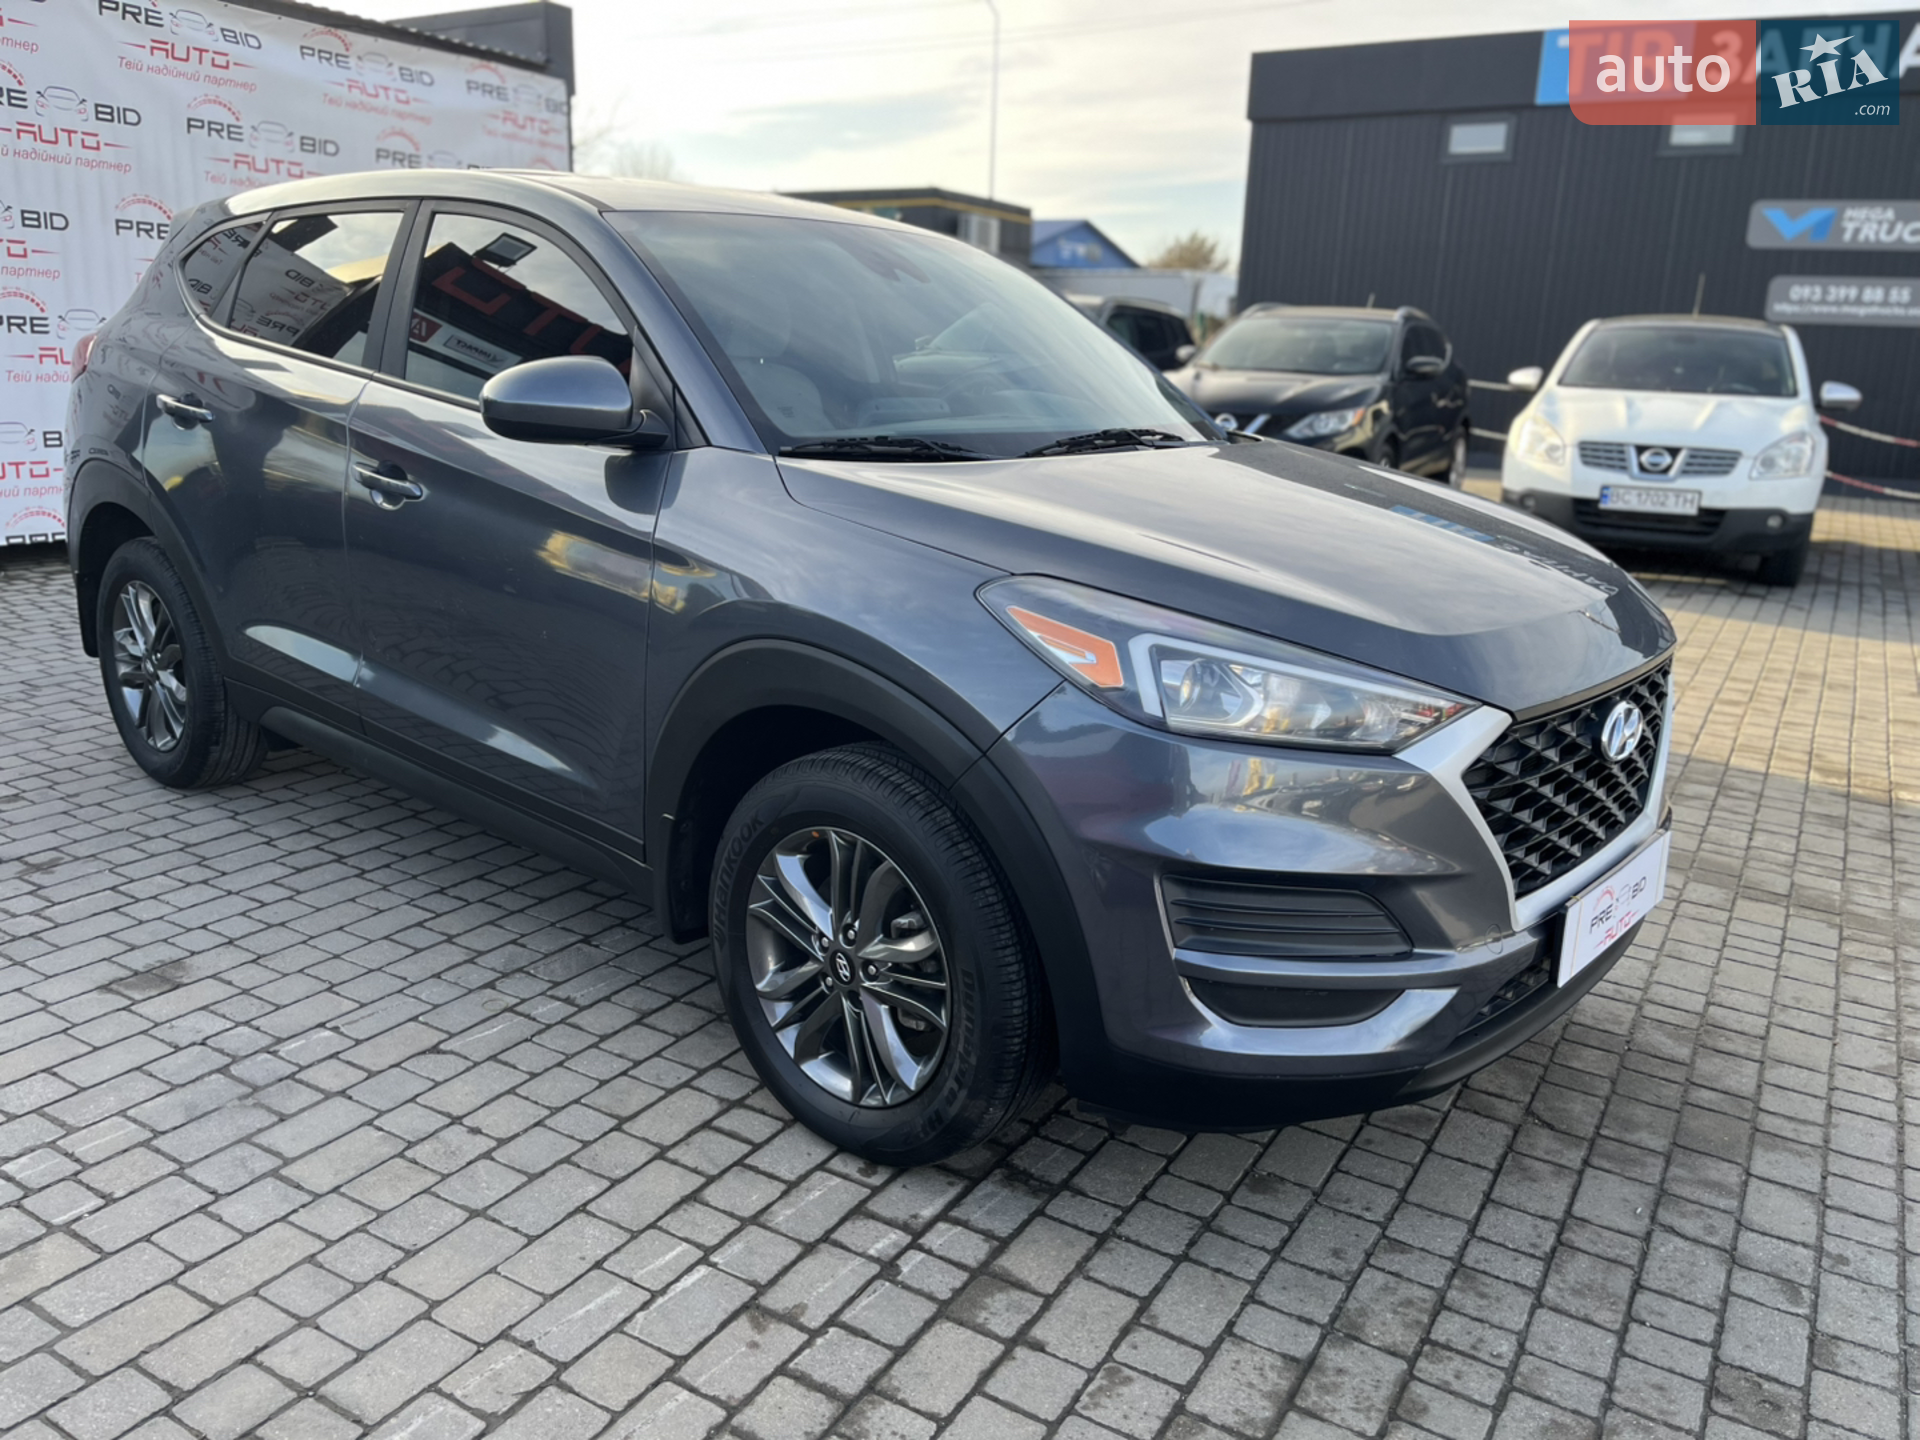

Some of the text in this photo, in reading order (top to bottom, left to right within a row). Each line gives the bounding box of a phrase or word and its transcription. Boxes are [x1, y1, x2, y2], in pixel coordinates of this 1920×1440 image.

[98, 0, 262, 50] PRE BID
[0, 36, 39, 54] тнер
[150, 39, 230, 70] AUTO
[118, 55, 143, 72] Твій
[203, 73, 257, 93] партнер
[300, 45, 435, 87] PRE BID
[346, 78, 411, 105] AUTO
[94, 103, 142, 127] BID
[16, 121, 101, 151] AUTO
[187, 117, 340, 157] PRE BID
[75, 157, 132, 175] партнер
[233, 153, 304, 179] AUTO
[20, 209, 69, 231] BID
[115, 219, 169, 240] PRE
[1, 266, 60, 281] партнер
[0, 315, 50, 334] RE
[36, 369, 70, 384] надій
